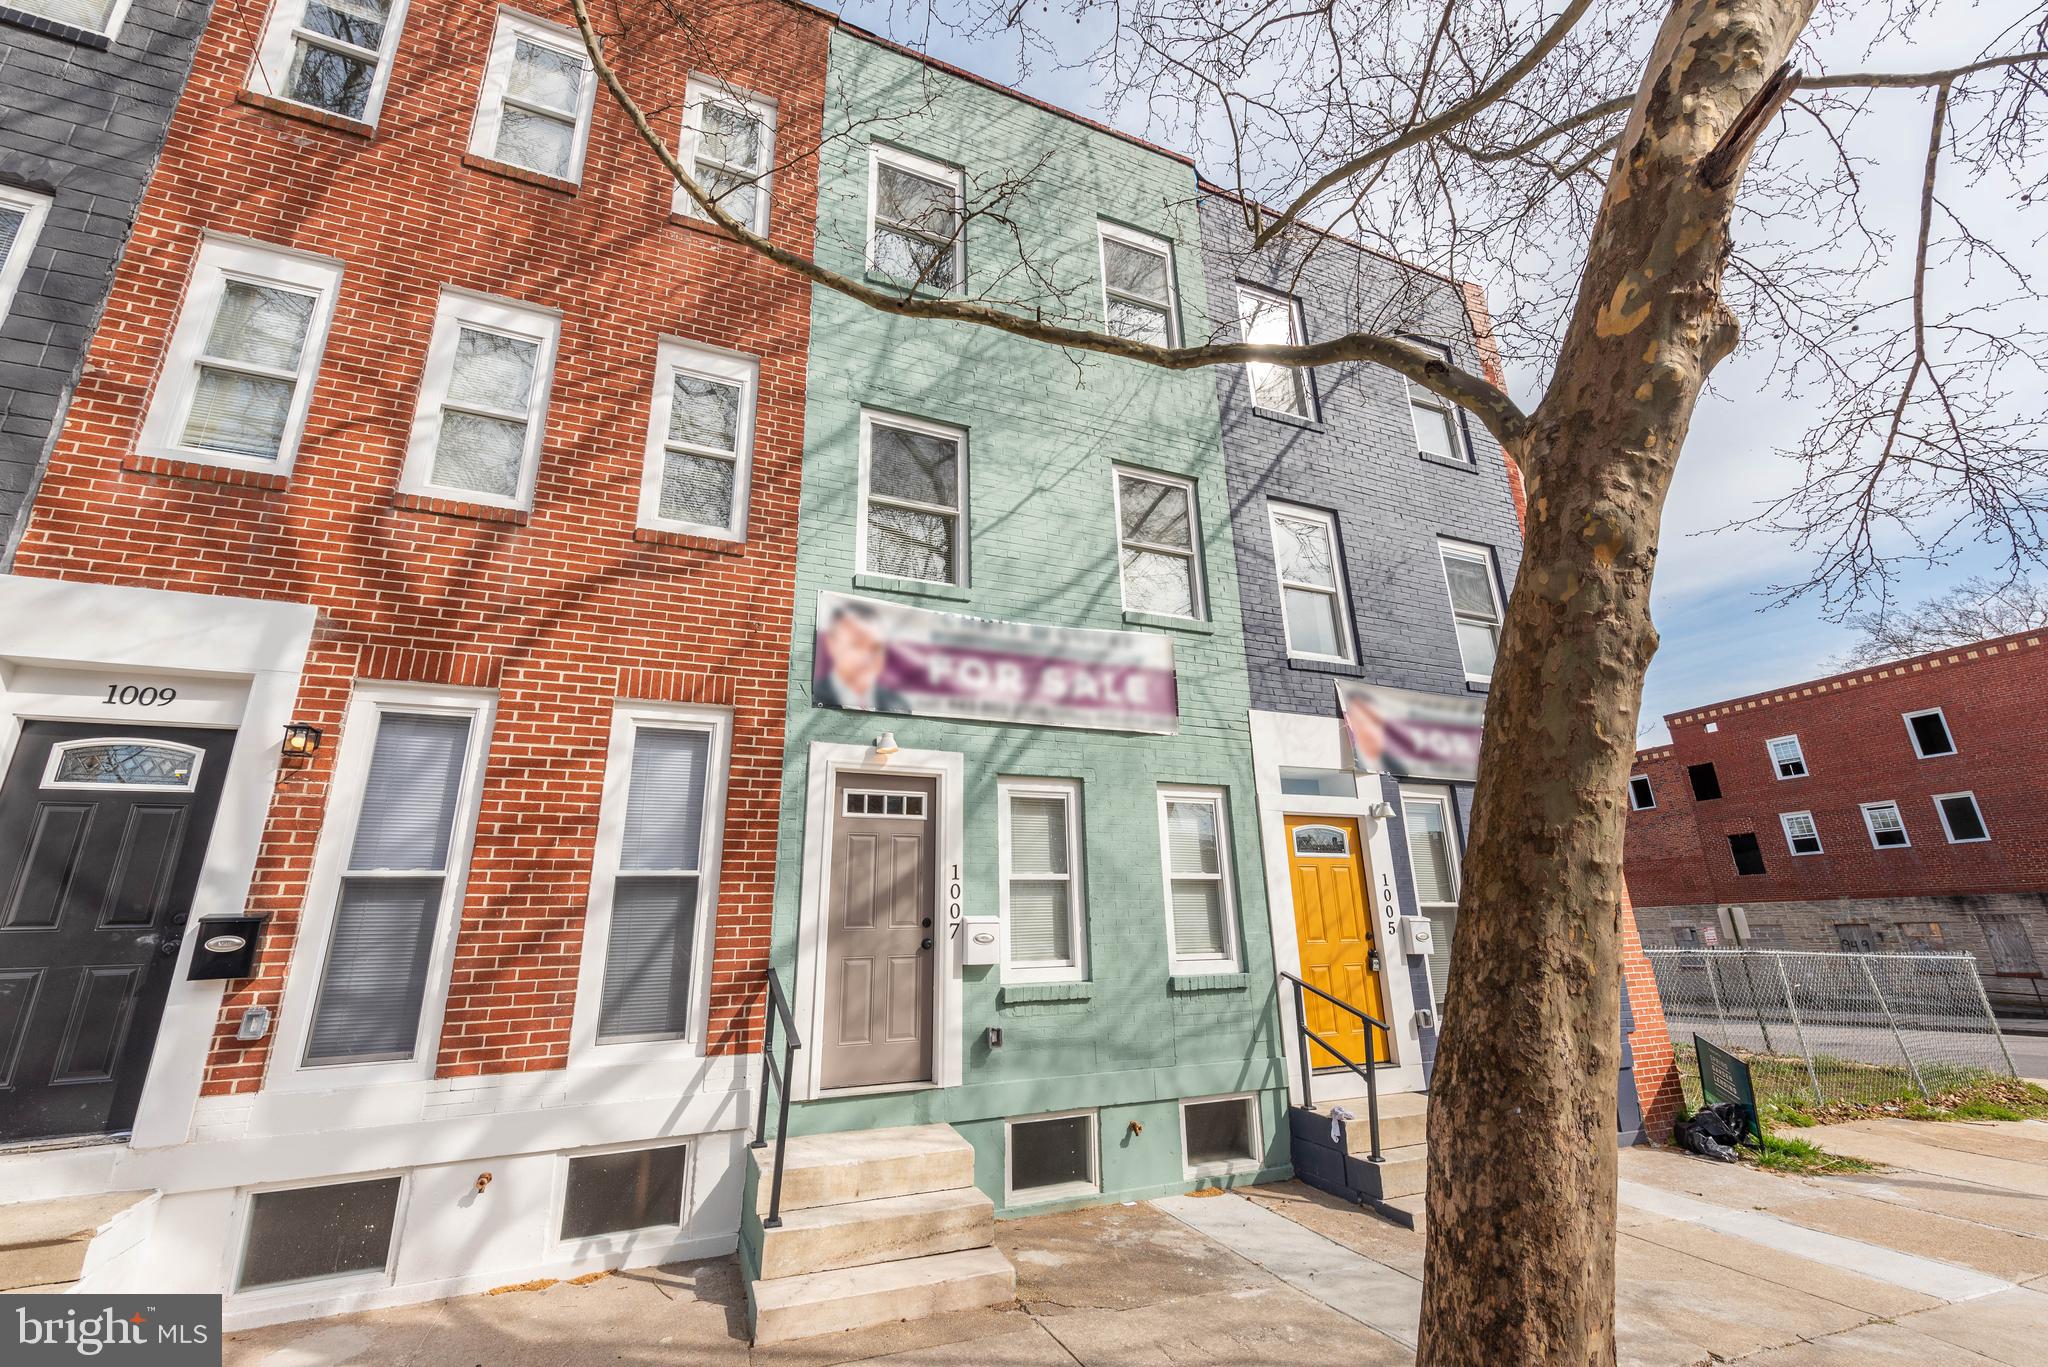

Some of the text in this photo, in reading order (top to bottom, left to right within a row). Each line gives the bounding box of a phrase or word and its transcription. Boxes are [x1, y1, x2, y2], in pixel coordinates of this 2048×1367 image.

[102, 684, 177, 707] 1009
[923, 655, 1149, 703] FOR SALE
[949, 864, 961, 940] 1007
[1382, 873, 1396, 936] 1005
[1711, 1064, 1733, 1082] GARDEN
[1713, 1074, 1737, 1095] LENDING
